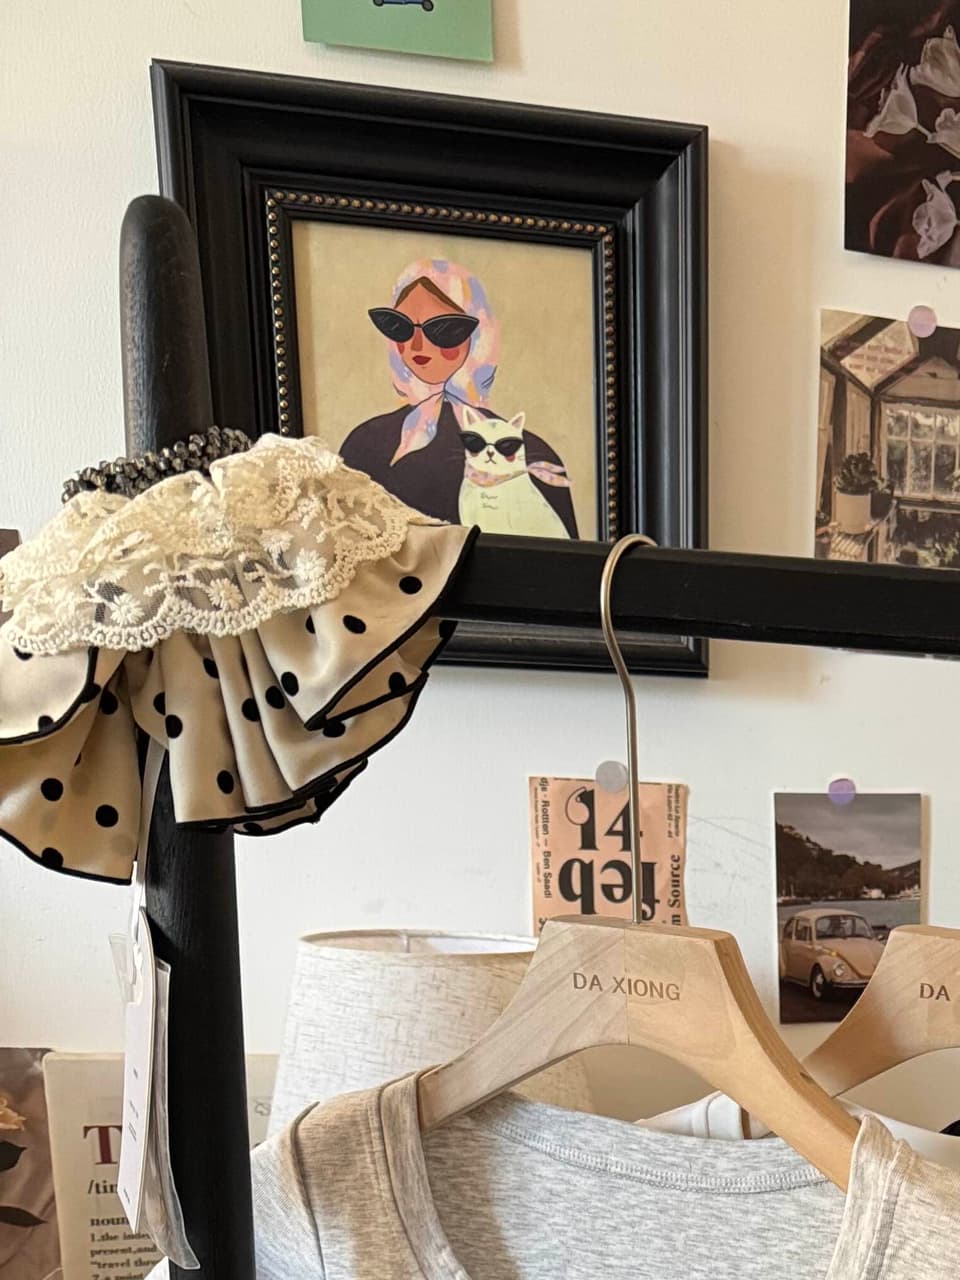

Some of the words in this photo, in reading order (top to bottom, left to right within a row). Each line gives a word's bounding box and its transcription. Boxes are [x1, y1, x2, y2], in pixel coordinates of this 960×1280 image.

[669, 854, 681, 909] Source
[573, 972, 603, 991] DA
[612, 978, 681, 1001] XIONG
[921, 982, 951, 1002] DA
